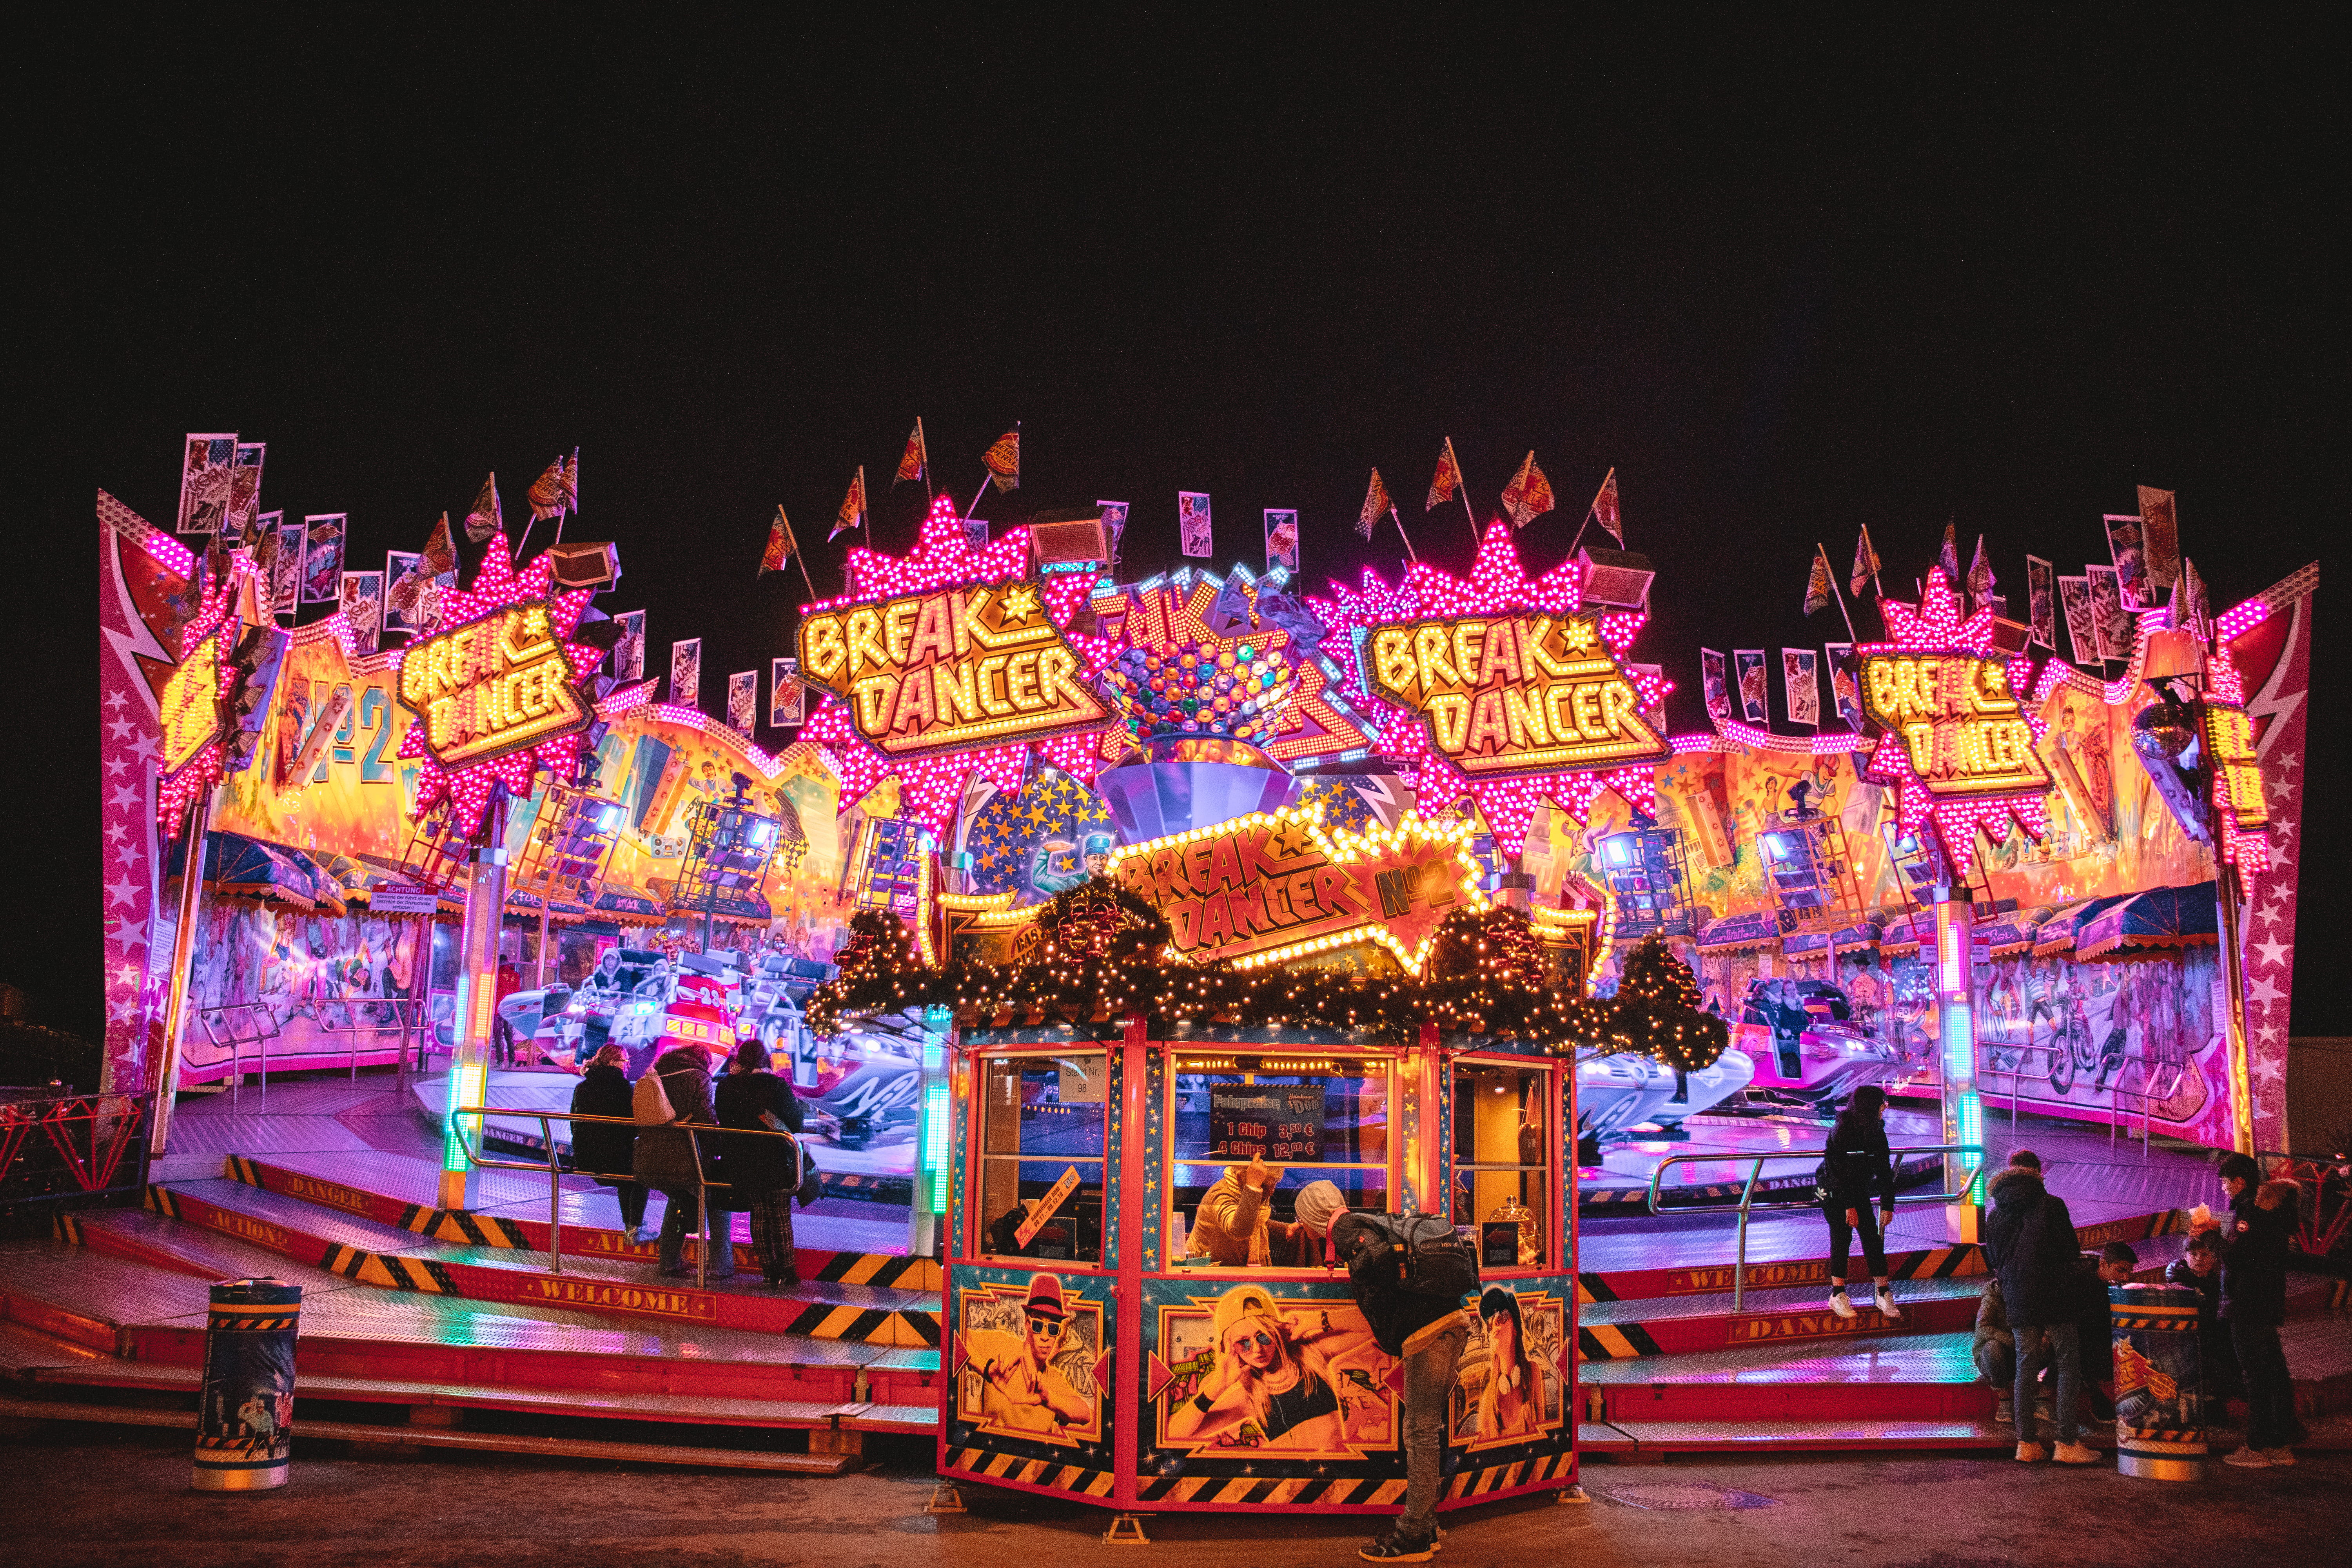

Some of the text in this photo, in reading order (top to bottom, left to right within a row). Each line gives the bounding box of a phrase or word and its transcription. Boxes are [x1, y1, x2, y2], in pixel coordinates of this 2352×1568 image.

[403, 610, 555, 699] BREAK
[802, 586, 1060, 683] BREAK
[1373, 615, 1615, 697] BREAK
[426, 659, 570, 750] DANCER
[853, 646, 1100, 739] DANCER
[1869, 655, 2018, 717] BREAK
[1422, 681, 1660, 756] DANCER
[1905, 718, 2044, 777] DANCER
[1118, 825, 1329, 909] BREAK
[1163, 864, 1355, 955] DANCER
[700, 987, 720, 1007] 23
[1077, 1083, 1087, 1093] 98
[1088, 1067, 1100, 1077] Nr.
[1218, 1141, 1227, 1155] 4
[1230, 1141, 1267, 1158] Chips
[1305, 1141, 1316, 1156] €
[1228, 1122, 1235, 1135] 1
[1238, 1122, 1267, 1139] Chip
[1304, 1122, 1315, 1137] €
[292, 1176, 363, 1209] DANGER
[1030, 1184, 1062, 1222] HAMBURGER DOM
[539, 1279, 689, 1313] WELCOME
[1749, 1316, 1863, 1337] DANGER
